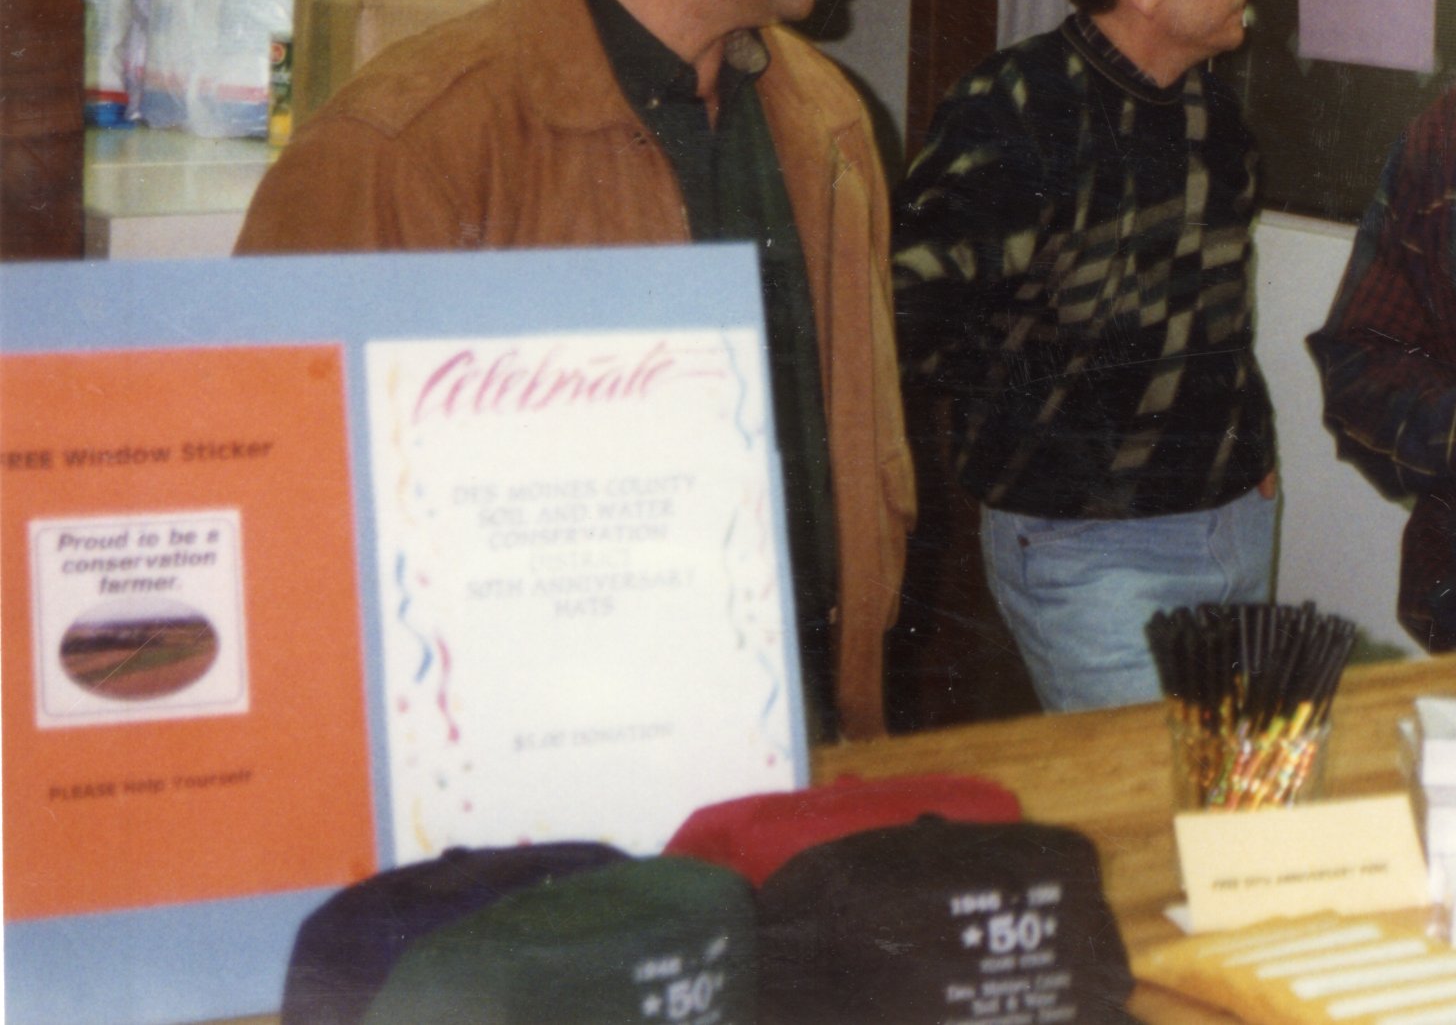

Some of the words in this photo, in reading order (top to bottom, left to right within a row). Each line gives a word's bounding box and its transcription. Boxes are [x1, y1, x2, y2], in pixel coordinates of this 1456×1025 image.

[411, 340, 680, 425] Celebrate
[63, 446, 171, 468] Window
[181, 441, 274, 463] Sticker
[451, 484, 498, 506] DES
[507, 479, 598, 501] MOINES
[605, 473, 696, 497] COUNTY
[537, 502, 589, 524] AND
[597, 496, 676, 519] WATER
[57, 528, 129, 552] Proud
[138, 530, 160, 548] to
[168, 527, 197, 545] be
[206, 529, 219, 544] a
[487, 522, 668, 552] CONSERVATION
[61, 551, 217, 575] conservation
[530, 565, 696, 597] ANNIVERSARY
[553, 594, 615, 620] HATS
[48, 781, 116, 802] PLEASE
[172, 769, 252, 789] Yourself
[987, 910, 1041, 954] 50
[665, 973, 711, 1021] 50
